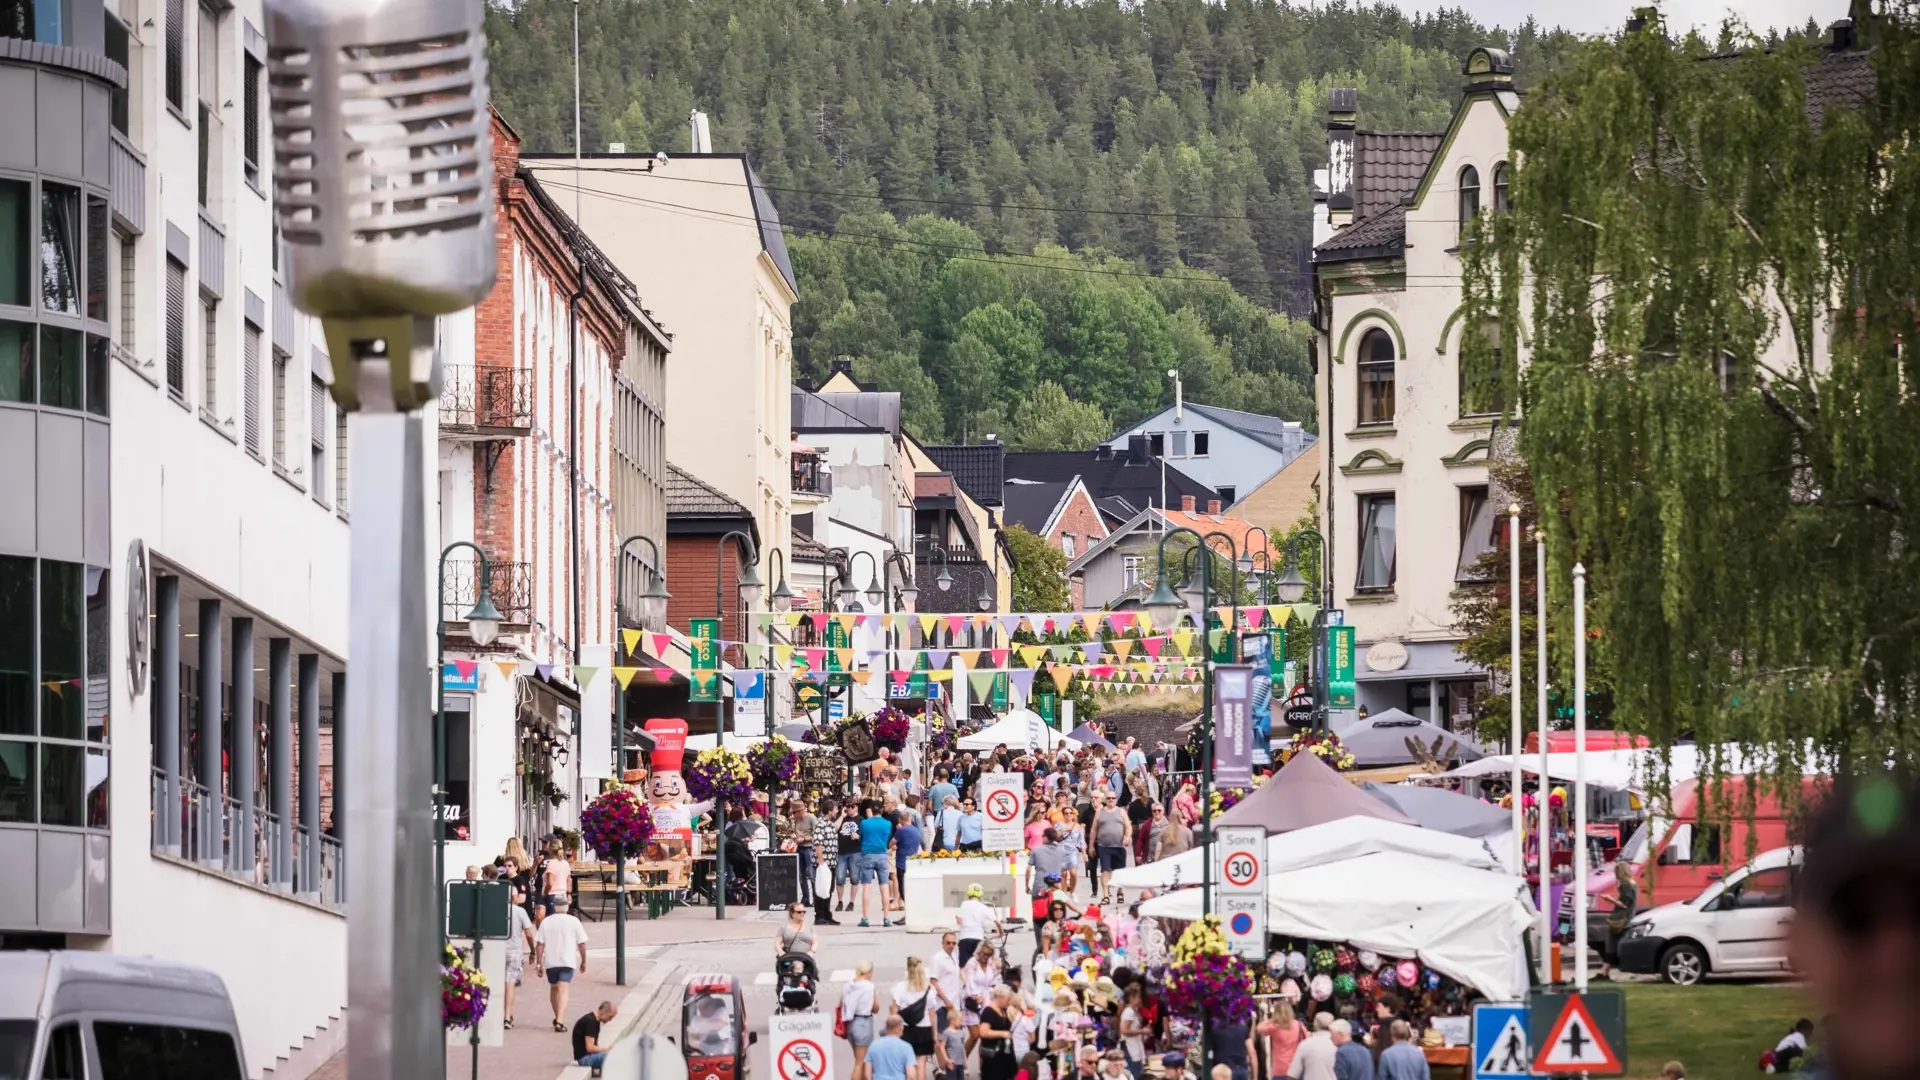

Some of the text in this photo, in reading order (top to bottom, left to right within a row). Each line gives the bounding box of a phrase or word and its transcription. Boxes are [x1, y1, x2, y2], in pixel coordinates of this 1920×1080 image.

[702, 624, 710, 661] UNESCO
[1340, 631, 1348, 668] UNESCO
[1234, 702, 1243, 756] NOTODDEN
[987, 776, 1018, 785] Gågate
[1226, 834, 1257, 845] Sone
[1231, 861, 1252, 877] 30
[1227, 900, 1257, 911] Sone
[777, 1021, 822, 1034] Gågate
